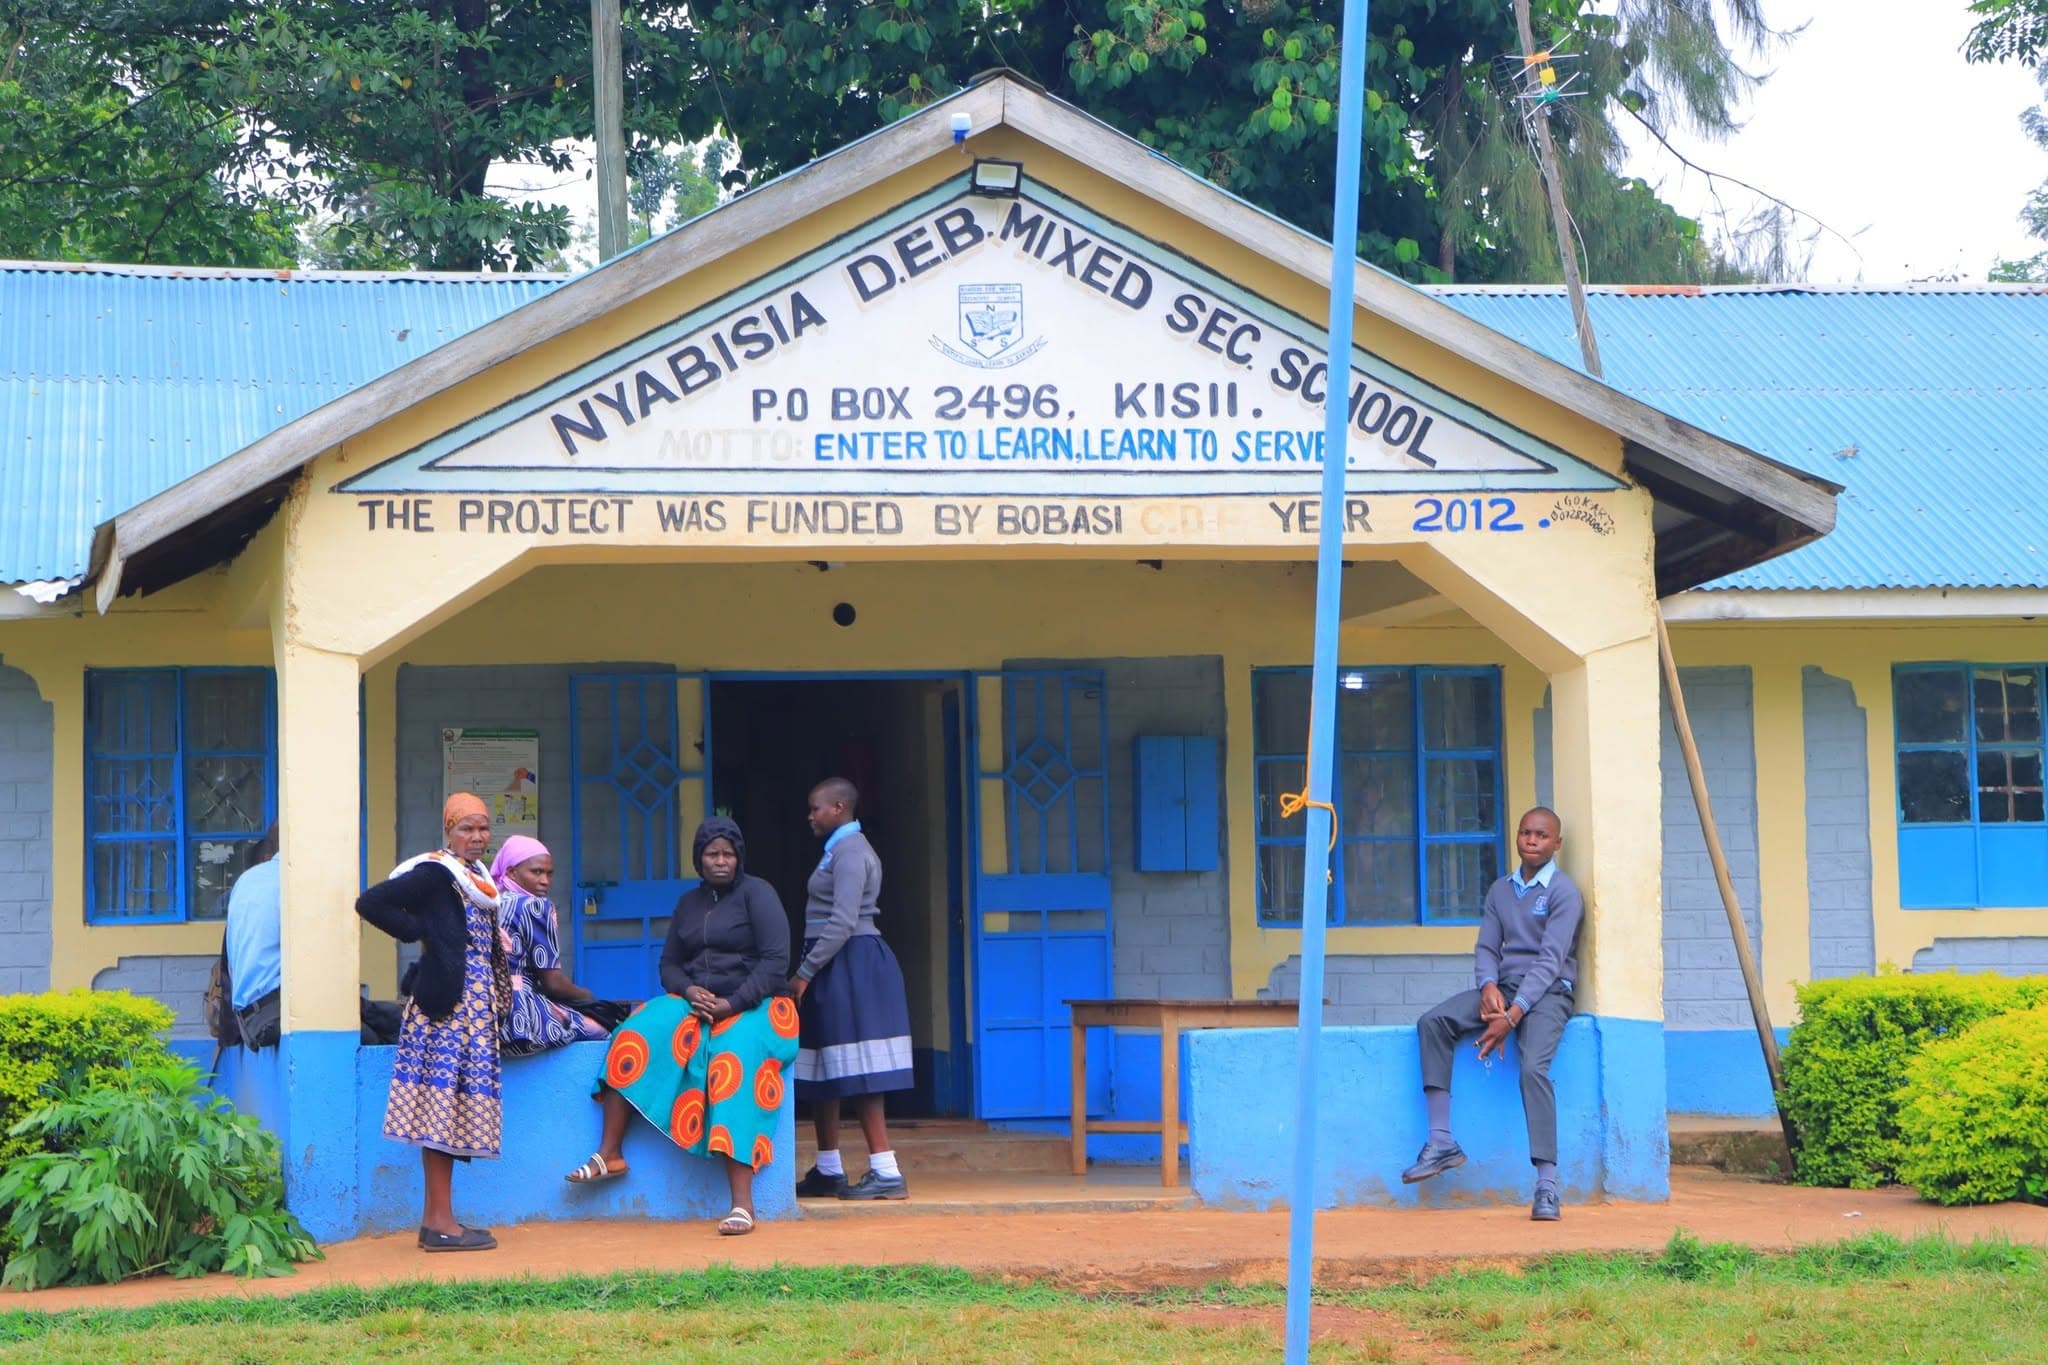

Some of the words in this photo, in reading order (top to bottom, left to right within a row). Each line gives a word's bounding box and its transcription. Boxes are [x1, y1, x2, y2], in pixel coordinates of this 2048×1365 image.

[550, 290, 828, 456] NYABISIA
[999, 201, 1153, 311] MIXED
[1165, 293, 1262, 370] SEC.
[752, 387, 809, 423] P.O
[831, 386, 913, 422] BOX
[934, 384, 1076, 422] 2496,
[815, 430, 928, 462] ENTER
[934, 428, 967, 461] TO
[1183, 427, 1218, 462] TO
[358, 498, 435, 532] THE
[459, 498, 633, 535] PROJECT
[656, 499, 727, 533] WAS
[747, 500, 904, 535] FUNDED
[934, 503, 983, 535] BY
[997, 504, 1123, 535] BOBASI
[1268, 499, 1374, 534] YER
